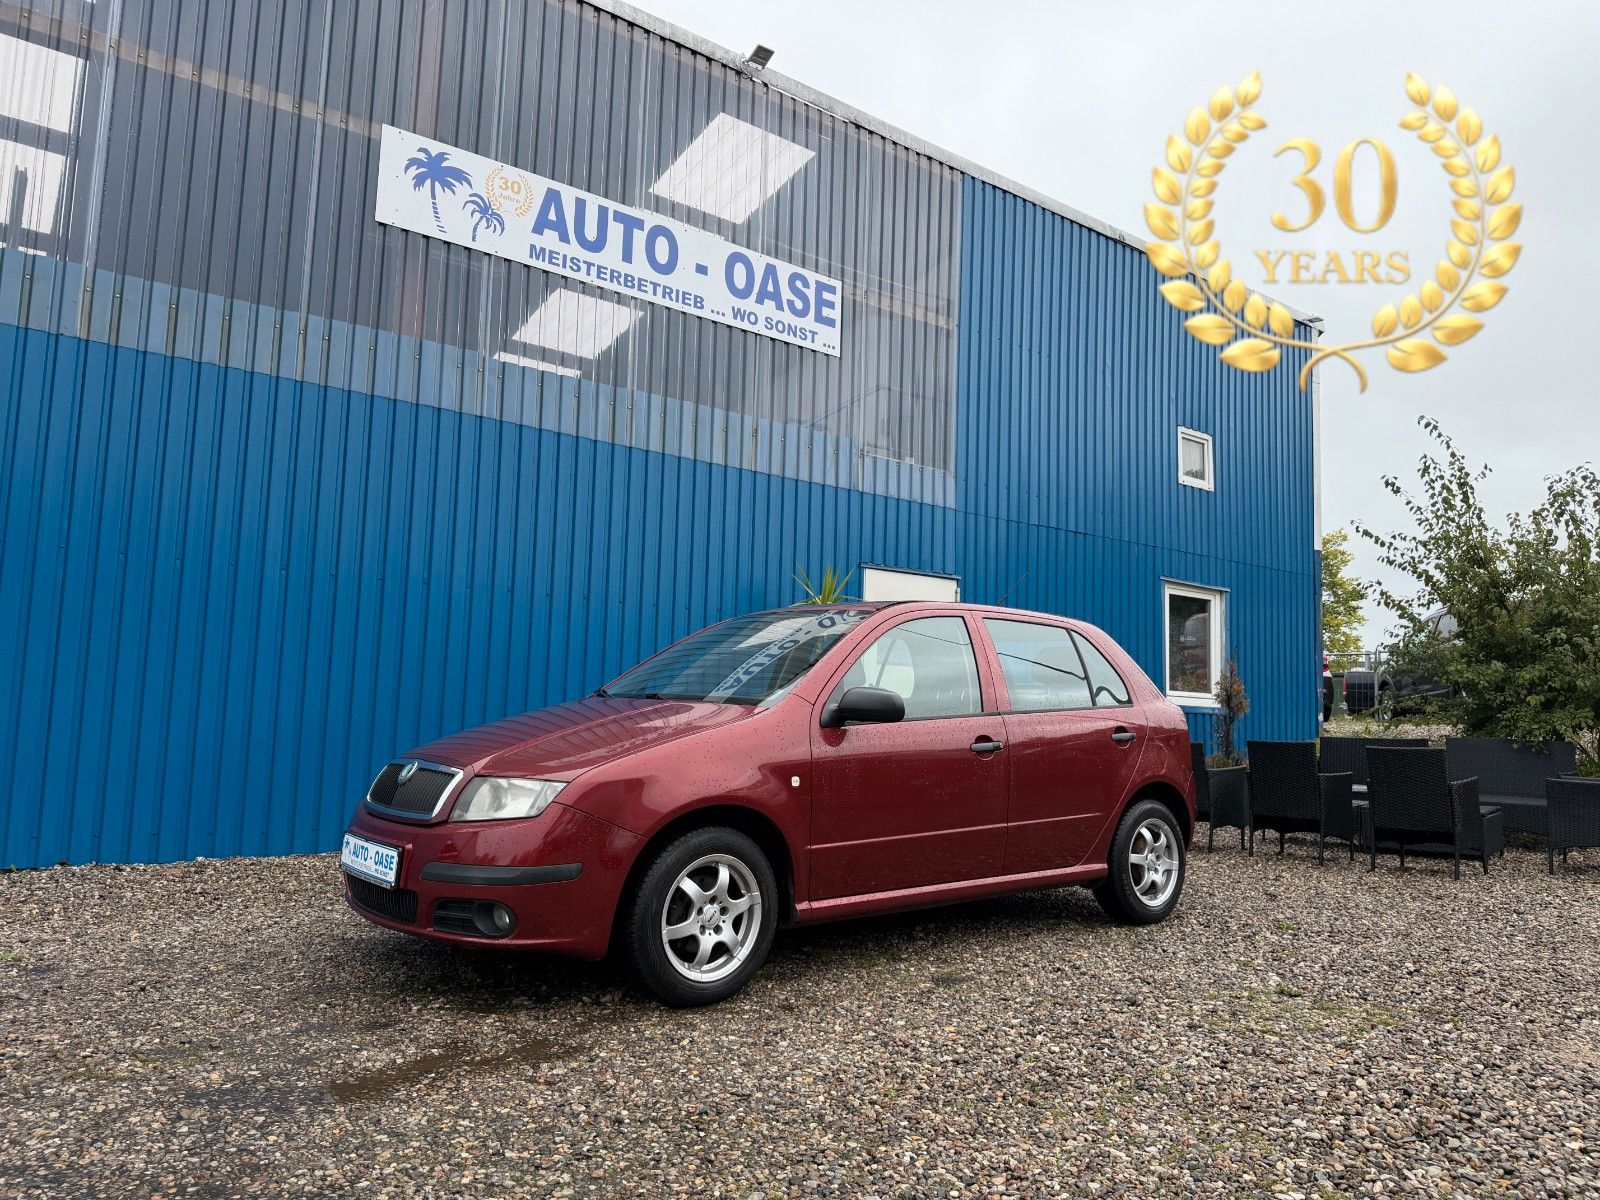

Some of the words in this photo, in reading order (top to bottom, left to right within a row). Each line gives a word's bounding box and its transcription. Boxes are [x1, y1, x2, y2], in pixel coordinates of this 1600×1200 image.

[499, 176, 521, 195] 30
[531, 187, 679, 275] AUTO
[725, 252, 837, 328] OASE
[529, 243, 705, 310] MEISTERBETRIEB
[732, 306, 759, 326] WO
[764, 316, 818, 344] SONST
[352, 843, 369, 862] AUTO
[374, 850, 395, 871] OASE
